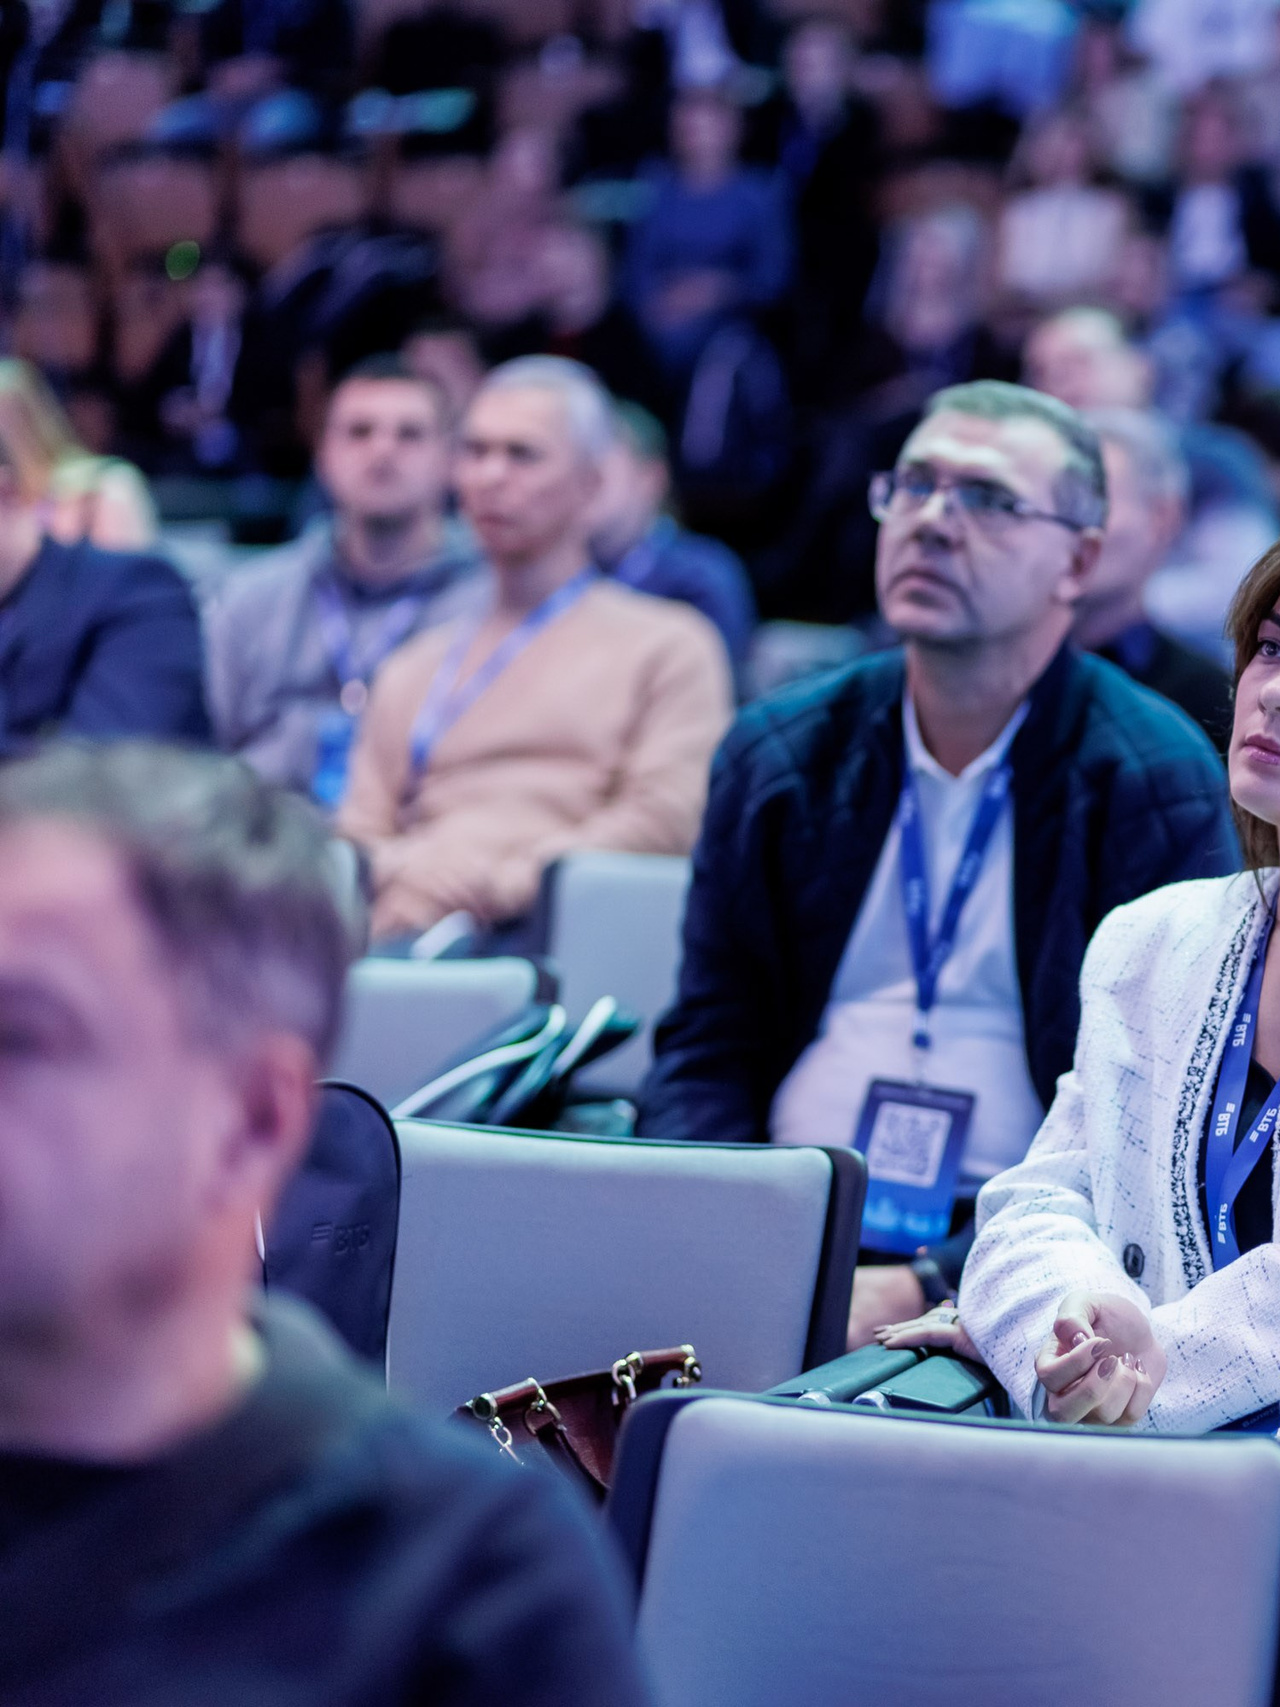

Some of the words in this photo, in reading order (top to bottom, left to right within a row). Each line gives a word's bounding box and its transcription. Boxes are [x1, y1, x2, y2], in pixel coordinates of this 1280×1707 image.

[1231, 1023, 1248, 1047] ВТБ
[1215, 1112, 1231, 1137] ВТБ
[1257, 1108, 1278, 1132] ВТБ
[1218, 1203, 1228, 1231] ВТБ
